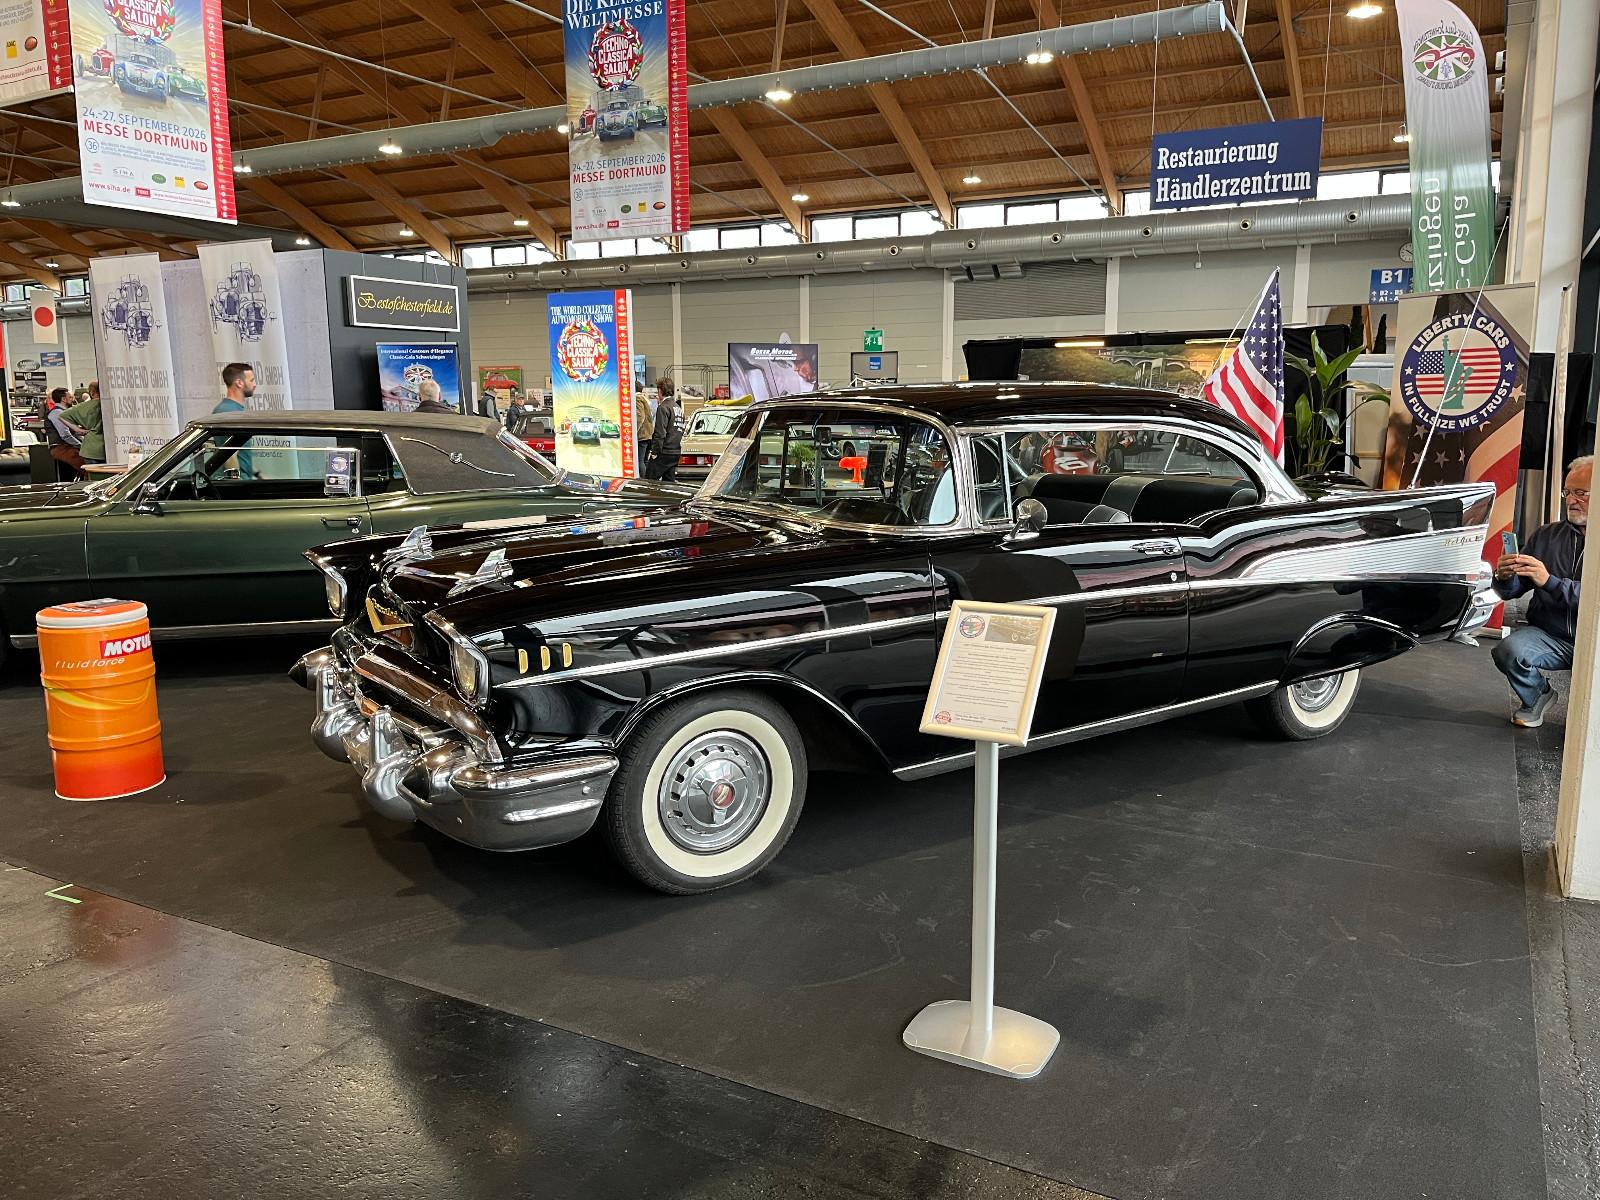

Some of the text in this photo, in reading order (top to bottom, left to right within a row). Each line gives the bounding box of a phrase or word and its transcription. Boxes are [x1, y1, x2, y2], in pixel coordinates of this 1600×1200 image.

[124, 6, 158, 27] SALON
[566, 1, 663, 30] WELTMESSE
[598, 44, 632, 64] CLASSICA
[602, 36, 629, 53] TECHNO
[604, 60, 628, 75] SALON
[82, 106, 206, 140] 24.-27. SEPTEMBER 2026
[84, 120, 208, 153] MESSE DORTMUND
[597, 156, 644, 170] SEPTEMBER
[646, 152, 666, 164] 2026
[1156, 140, 1279, 170] Restaurierung
[572, 164, 666, 184] MESSE DORTMUND
[88, 182, 131, 193] www.siha.de
[1155, 170, 1311, 203] Händlerzentrum
[1380, 270, 1403, 284] B1
[358, 292, 454, 318] Bestofchesterfield.de
[550, 304, 614, 316] THE WORLD COLLECTOR
[594, 314, 612, 324] SHOW
[570, 335, 594, 348] TECHNO
[1412, 314, 1510, 353] LIBERTY CARS
[566, 344, 598, 358] CLASSICA
[572, 356, 594, 368] SALON
[1404, 378, 1512, 430] IN FULLSIZE WE TRUST
